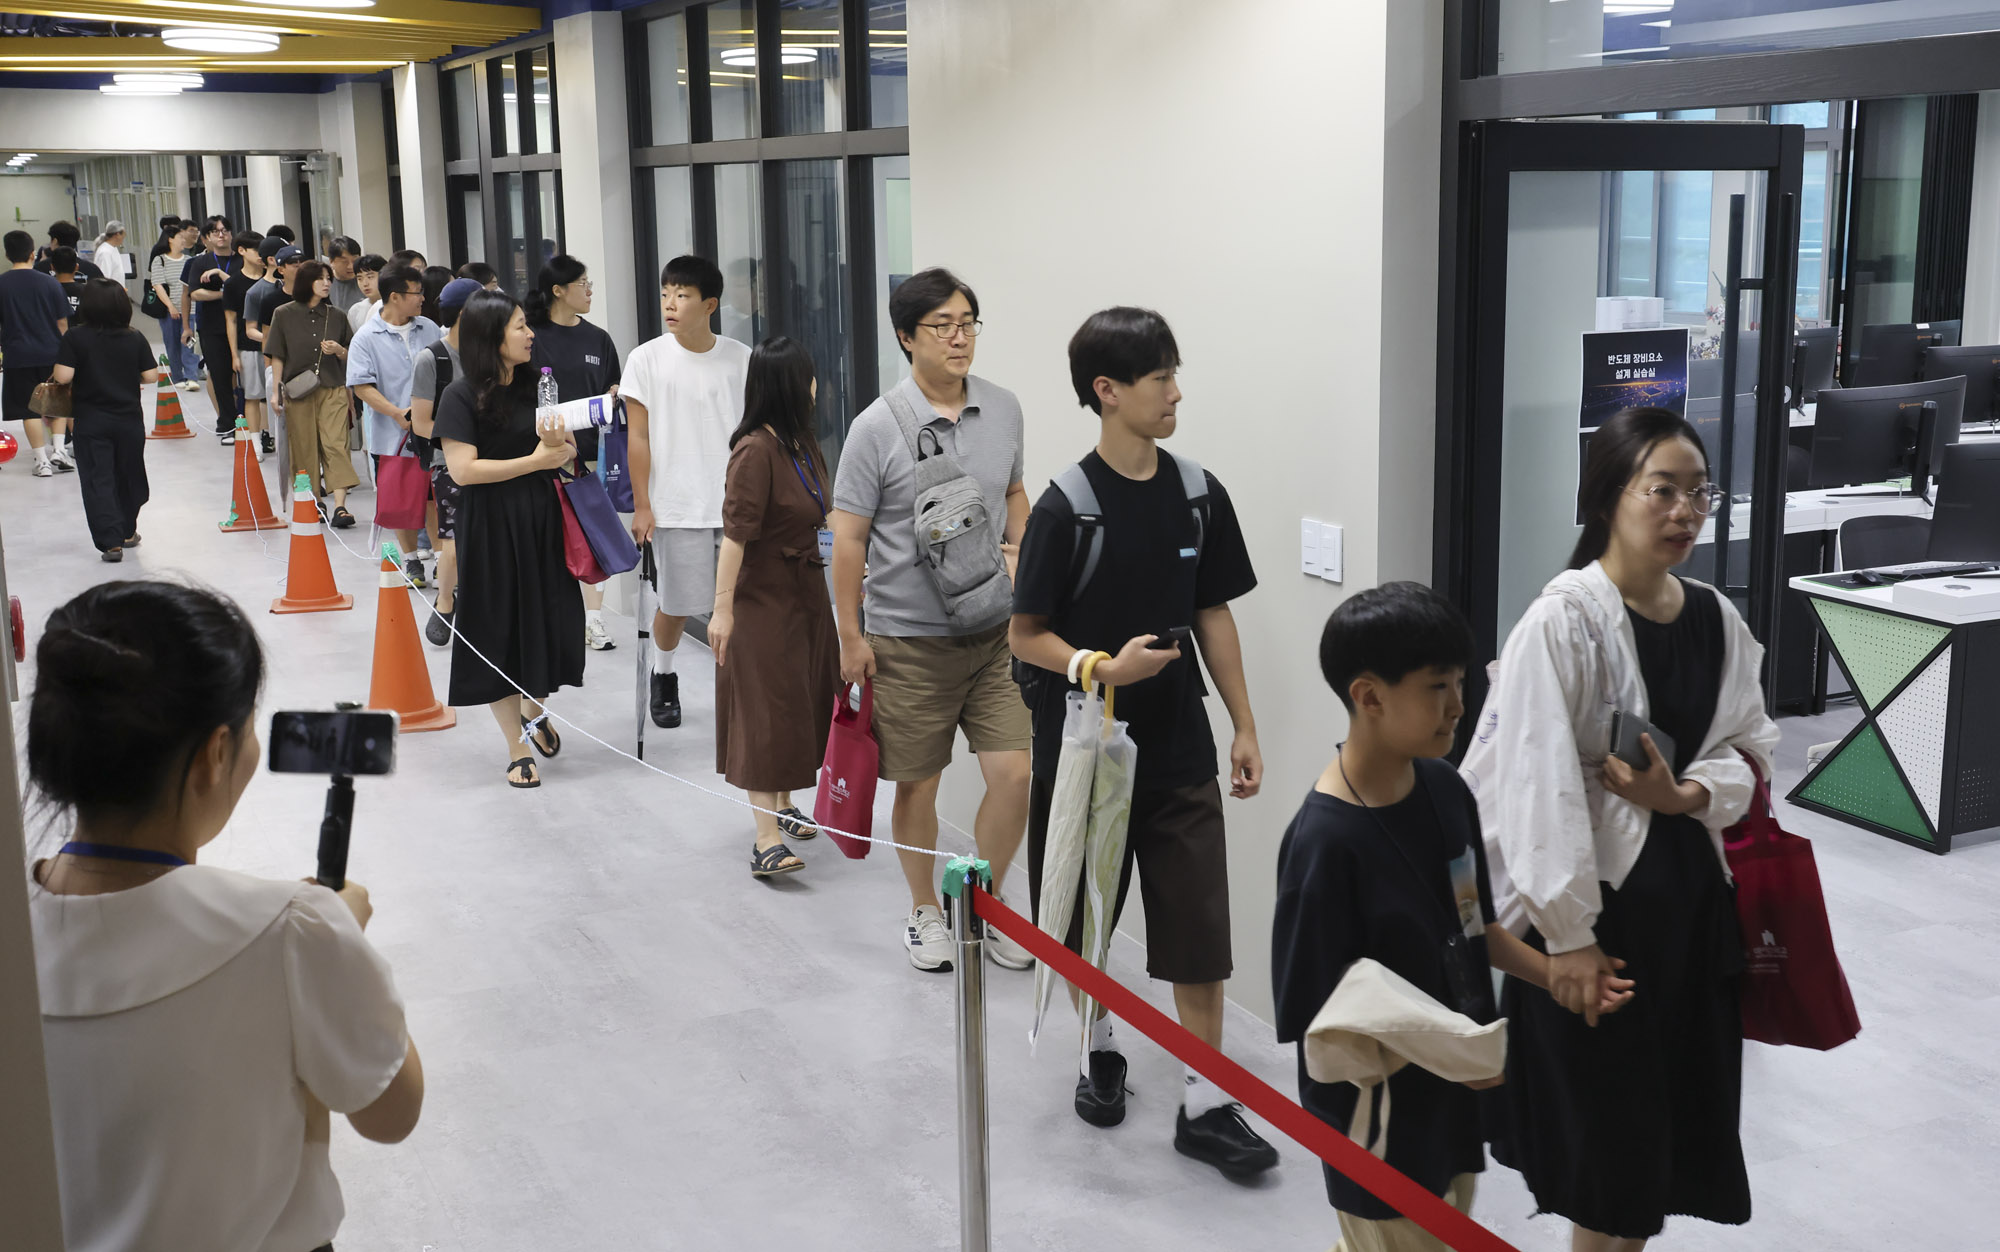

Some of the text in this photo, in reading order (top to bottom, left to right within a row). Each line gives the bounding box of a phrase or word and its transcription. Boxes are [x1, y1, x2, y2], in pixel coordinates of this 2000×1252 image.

[1608, 352, 1663, 365] 반도체 장비요소
[1616, 367, 1656, 380] 설계 실습실
